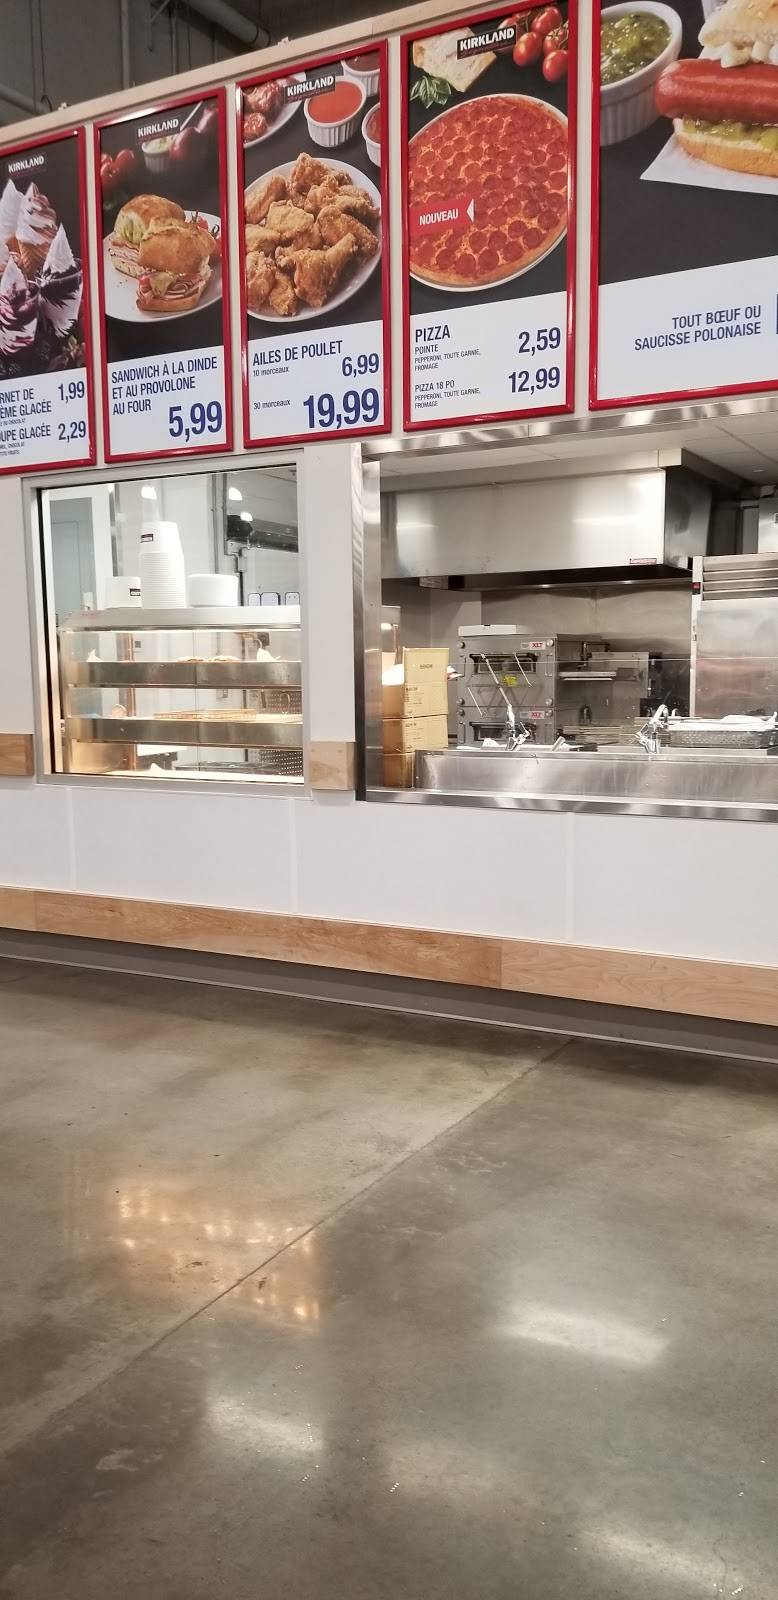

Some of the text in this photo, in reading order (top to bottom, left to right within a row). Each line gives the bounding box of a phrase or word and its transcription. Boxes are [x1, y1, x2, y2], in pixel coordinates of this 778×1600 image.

[460, 28, 515, 51] KIRKLAND
[287, 75, 334, 97] KIRKLAND
[138, 118, 179, 138] KIRKLAND
[8, 155, 45, 174] KIRKLAND
[419, 208, 459, 225] NOUVEAU
[672, 305, 761, 329] TOUT BŒUF OU
[415, 324, 450, 343] PIZZA
[518, 327, 561, 357] 2,59
[634, 322, 761, 351] SAUCISSE POLONAISE
[252, 340, 343, 367] AILES DE POULET
[414, 344, 439, 355] POINTE
[444, 351, 460, 359] TOUTE
[111, 356, 218, 384] SANDWICH À LA DINDE
[253, 366, 289, 377] 10 morceaux
[341, 353, 379, 378] 6,99
[414, 362, 439, 371] FROMAGE
[112, 376, 196, 400] ET AU PROVOLONE
[414, 379, 455, 392] PIZZA 18 PO
[508, 366, 560, 395] 12,99
[23, 388, 35, 401] DE
[58, 380, 85, 404] 1,99
[444, 390, 460, 398] TOUTE
[20, 398, 52, 416] GLACÉE
[112, 399, 152, 416] AU FOUR
[253, 399, 291, 410] 30 morceaux
[303, 387, 380, 429] 19,99
[414, 400, 439, 409] FROMAGE
[19, 422, 51, 440] GLACÉE
[169, 400, 223, 443] 5,99
[58, 420, 86, 443] 2,29
